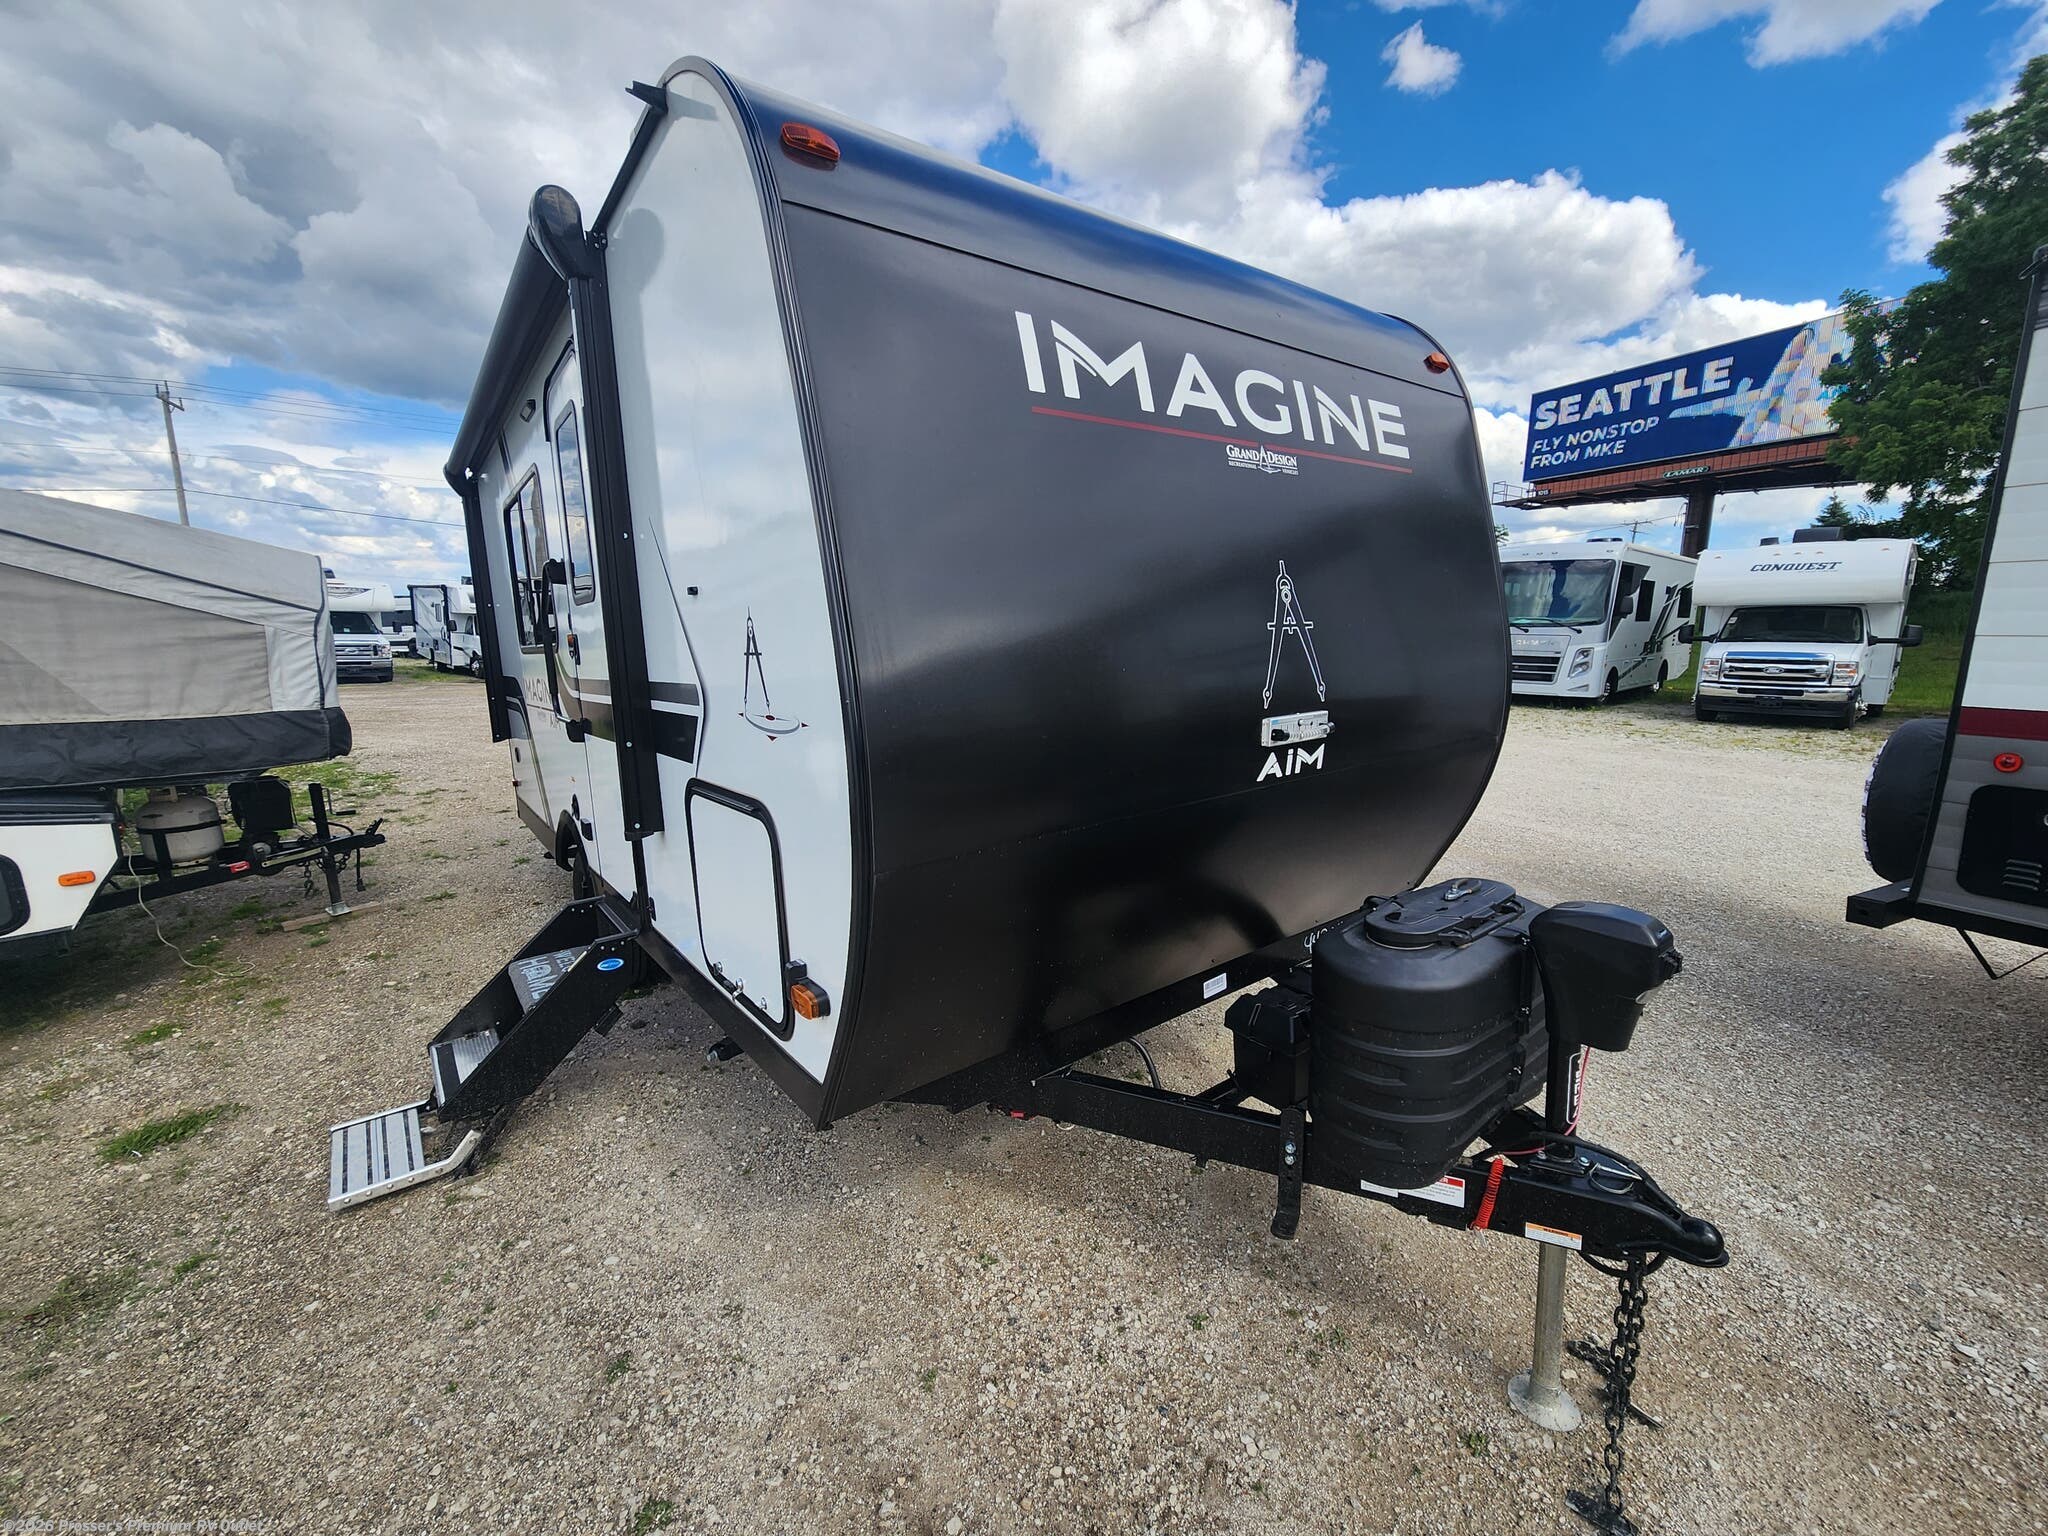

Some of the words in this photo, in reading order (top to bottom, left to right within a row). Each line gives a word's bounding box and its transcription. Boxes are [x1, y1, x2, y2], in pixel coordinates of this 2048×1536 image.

[1014, 310, 1411, 460] IMAGINE
[1533, 355, 1735, 431] SEATTLE
[1531, 435, 1564, 454] FLY
[1566, 416, 1660, 448] NONSTOP
[1225, 444, 1260, 461] GRAND
[1266, 450, 1298, 467] DESIGN
[1530, 448, 1581, 469] FROM
[1583, 439, 1627, 460] MKE
[1665, 466, 1704, 478] LAMAR
[1749, 561, 1843, 572] CONQUEST
